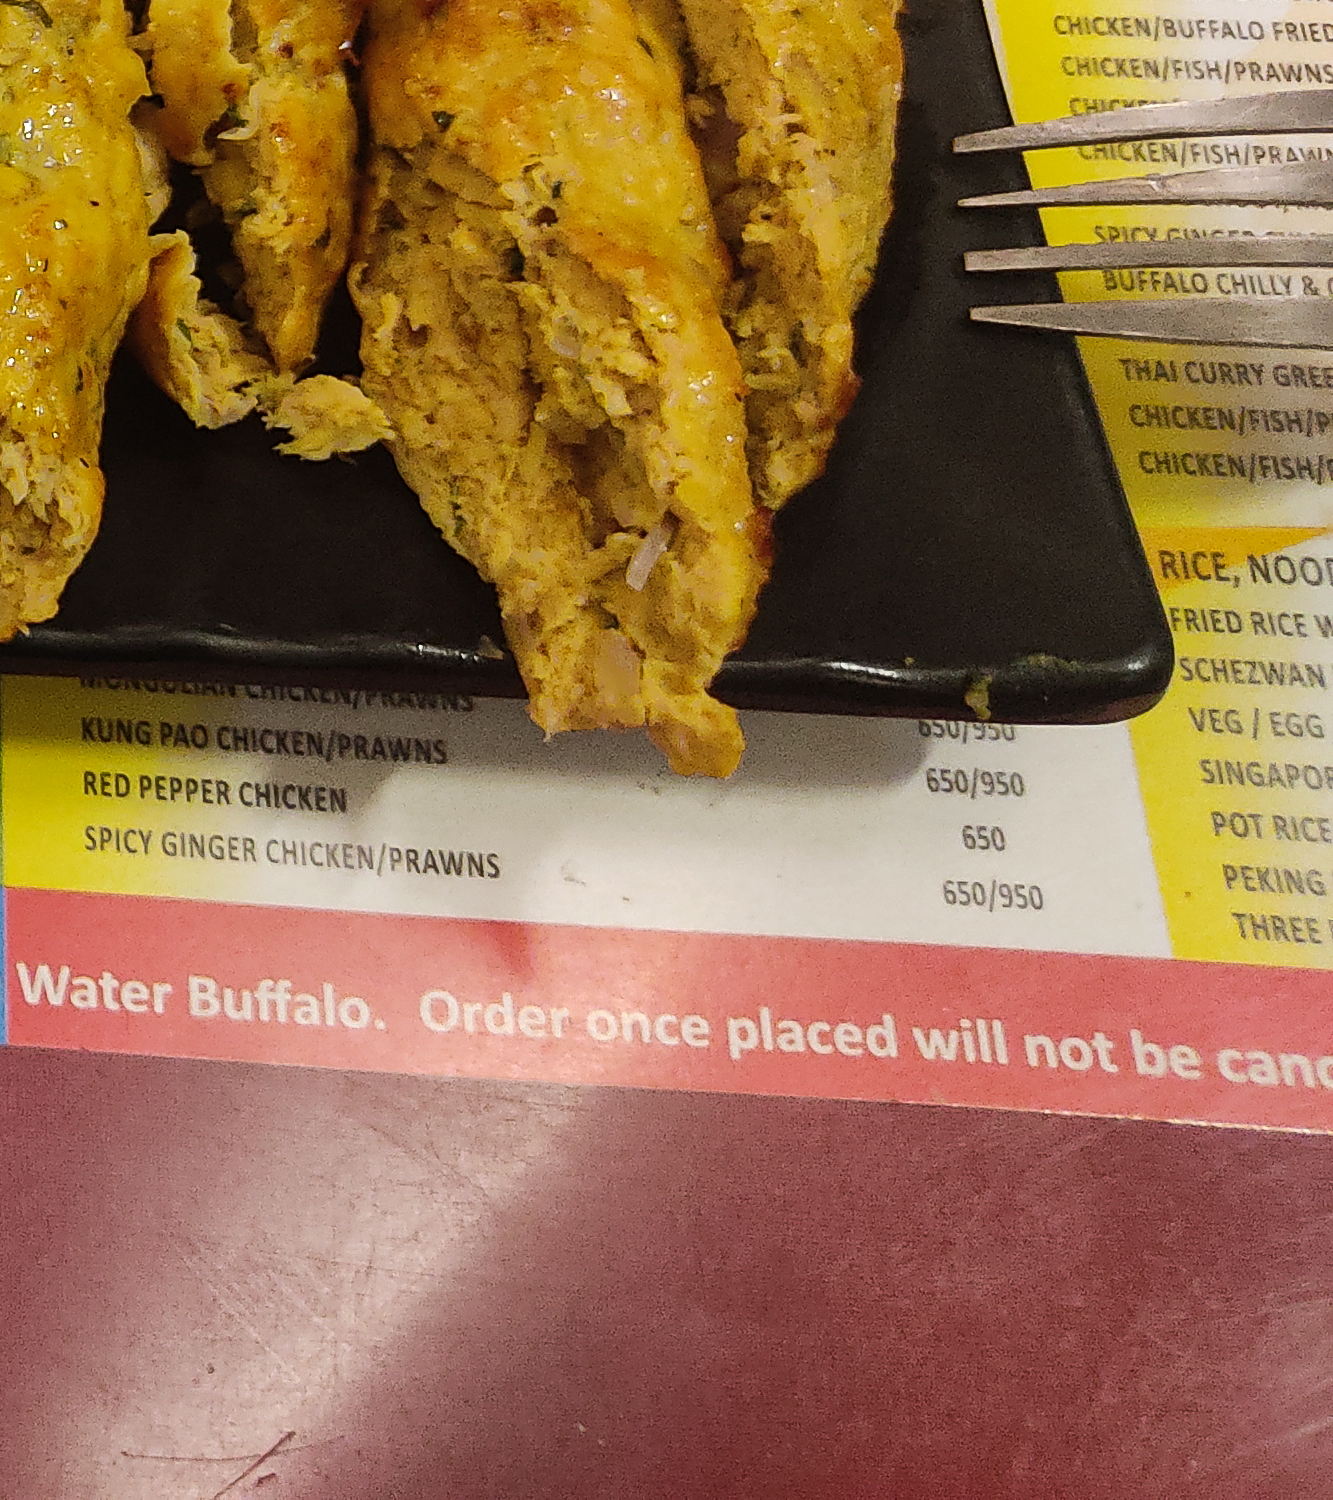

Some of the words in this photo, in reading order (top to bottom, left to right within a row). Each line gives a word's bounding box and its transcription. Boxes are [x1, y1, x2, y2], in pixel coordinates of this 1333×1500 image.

[1054, 16, 1264, 41] CHICKEN/BUFFALO
[1105, 270, 1208, 293] BUFFALO
[1217, 273, 1292, 296] CHILLY
[1302, 277, 1319, 295] &
[1120, 359, 1178, 382] THAI
[1185, 361, 1264, 385] CURRY
[1159, 551, 1240, 588] RICE,
[1171, 607, 1242, 633] FRIED
[1252, 612, 1306, 638] RICE
[1180, 658, 1325, 688] SCHEZWAN
[1191, 708, 1242, 734] VEG
[1271, 712, 1324, 738] EGG
[81, 716, 151, 746] KUNG
[160, 722, 209, 749] PAO
[217, 725, 448, 765] CHICKEN/PRAWNS
[83, 771, 131, 799] RED
[139, 774, 232, 806] PEPPER
[239, 780, 348, 813] CHICKEN
[925, 768, 1026, 801] 650/950
[962, 825, 1005, 852] 650
[1212, 813, 1261, 838] POT
[1272, 815, 1332, 843] RICE
[85, 826, 153, 858] SPICY
[161, 831, 257, 864] GINGER
[265, 838, 501, 881] CHICKEN/PRAWNS
[942, 879, 1044, 912] 650/950
[1223, 865, 1326, 896] PEKING
[1232, 914, 1321, 944] THREE
[16, 963, 172, 1016] Water
[188, 975, 385, 1031] Buffalo.
[419, 989, 572, 1040] Order
[586, 1008, 710, 1050] once
[728, 1007, 897, 1061] placed
[913, 1016, 1007, 1066] will
[1025, 1032, 1118, 1073] not
[1132, 1029, 1202, 1079] be
